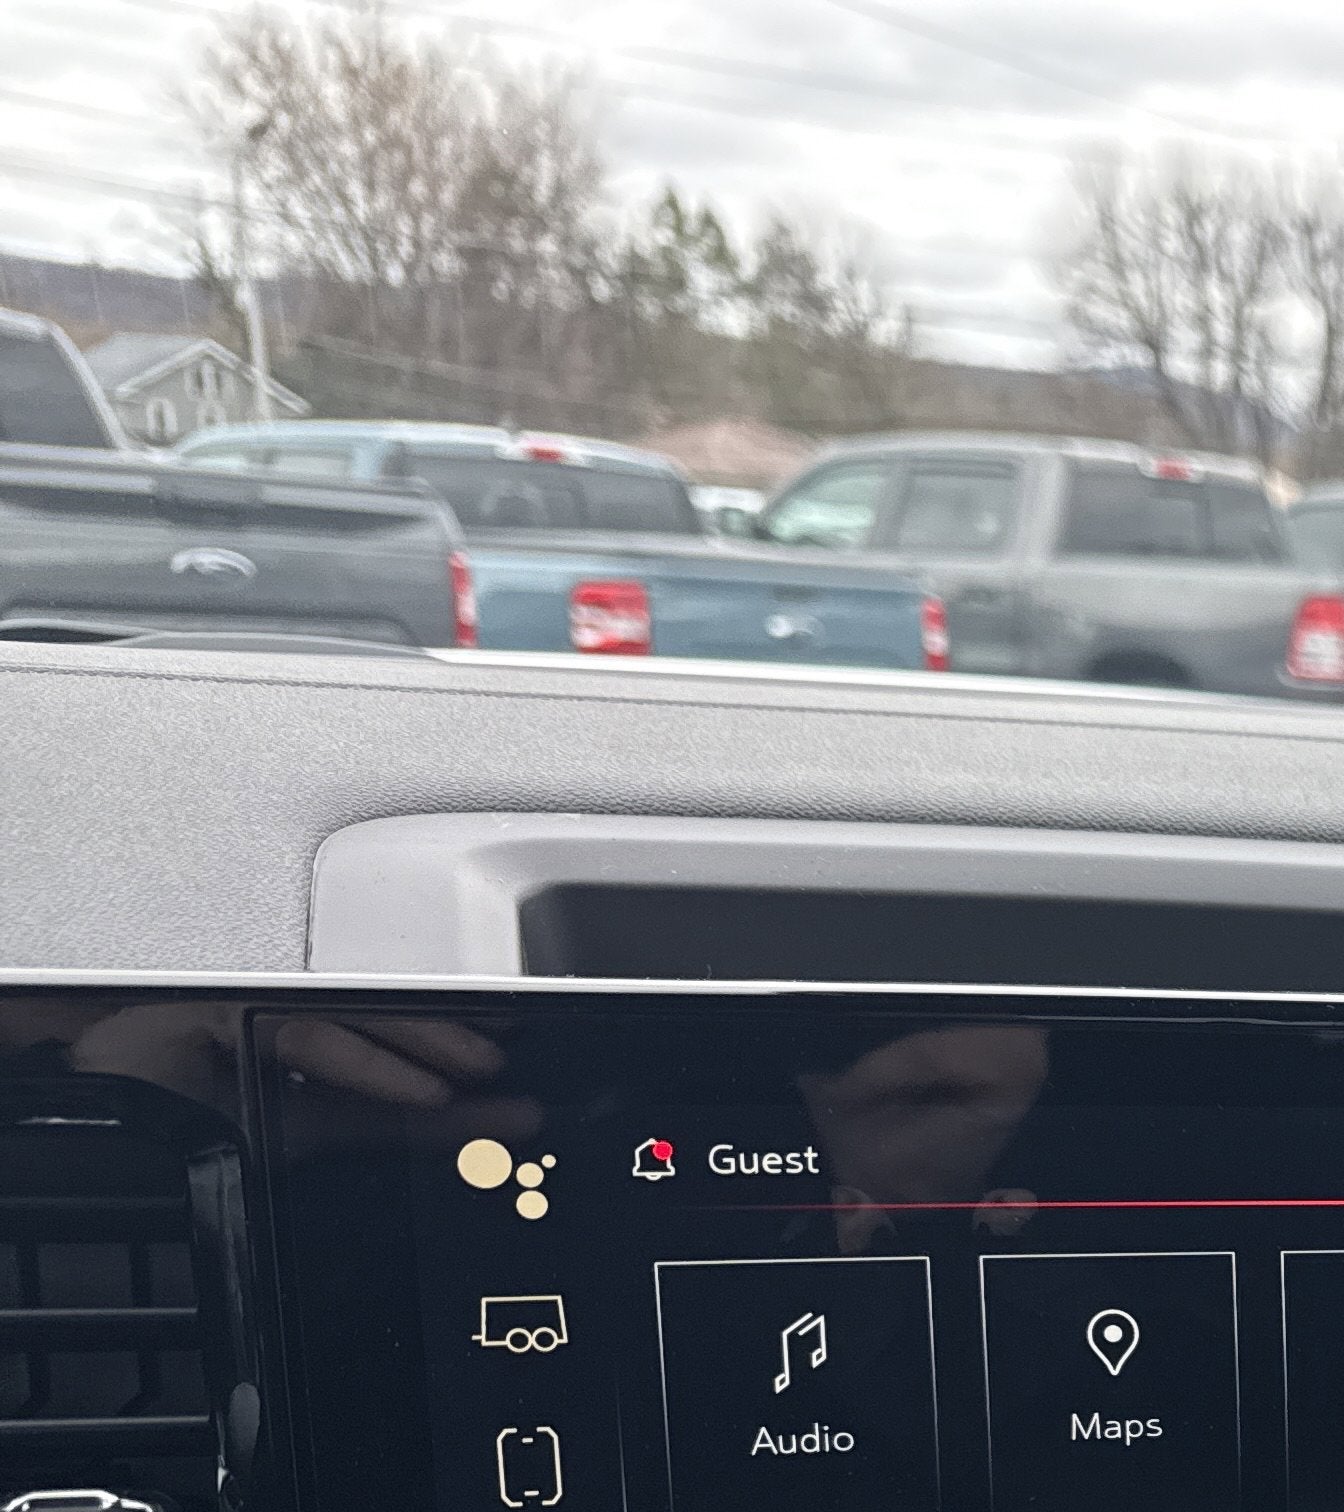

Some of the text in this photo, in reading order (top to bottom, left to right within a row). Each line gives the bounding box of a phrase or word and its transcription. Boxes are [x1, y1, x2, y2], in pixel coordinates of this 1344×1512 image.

[708, 1143, 820, 1175] Guest
[751, 1422, 855, 1456] Audio
[1071, 1412, 1164, 1447] Maps
